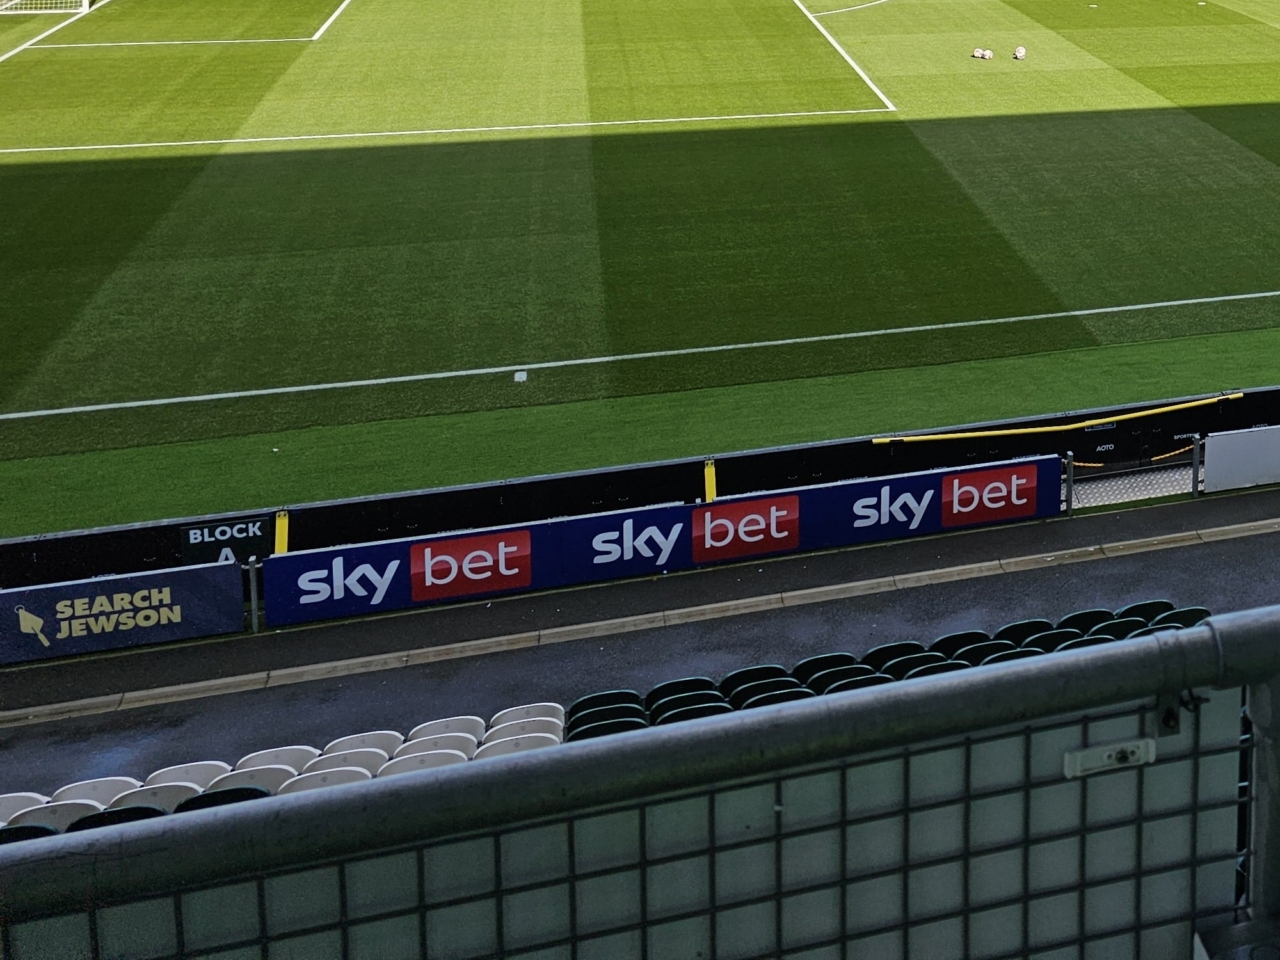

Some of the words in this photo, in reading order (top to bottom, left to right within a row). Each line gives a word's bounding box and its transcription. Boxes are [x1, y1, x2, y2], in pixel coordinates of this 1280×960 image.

[1096, 443, 1114, 452] AOTO
[852, 485, 935, 529] sky
[952, 474, 1027, 514] bet
[189, 522, 262, 544] BLOCK
[592, 518, 684, 565] sky
[704, 505, 789, 549] bet
[218, 547, 236, 562] A
[297, 556, 401, 605] sky
[423, 541, 520, 586] bet
[56, 587, 172, 619] SEARCH
[55, 605, 182, 639] JEWSON
